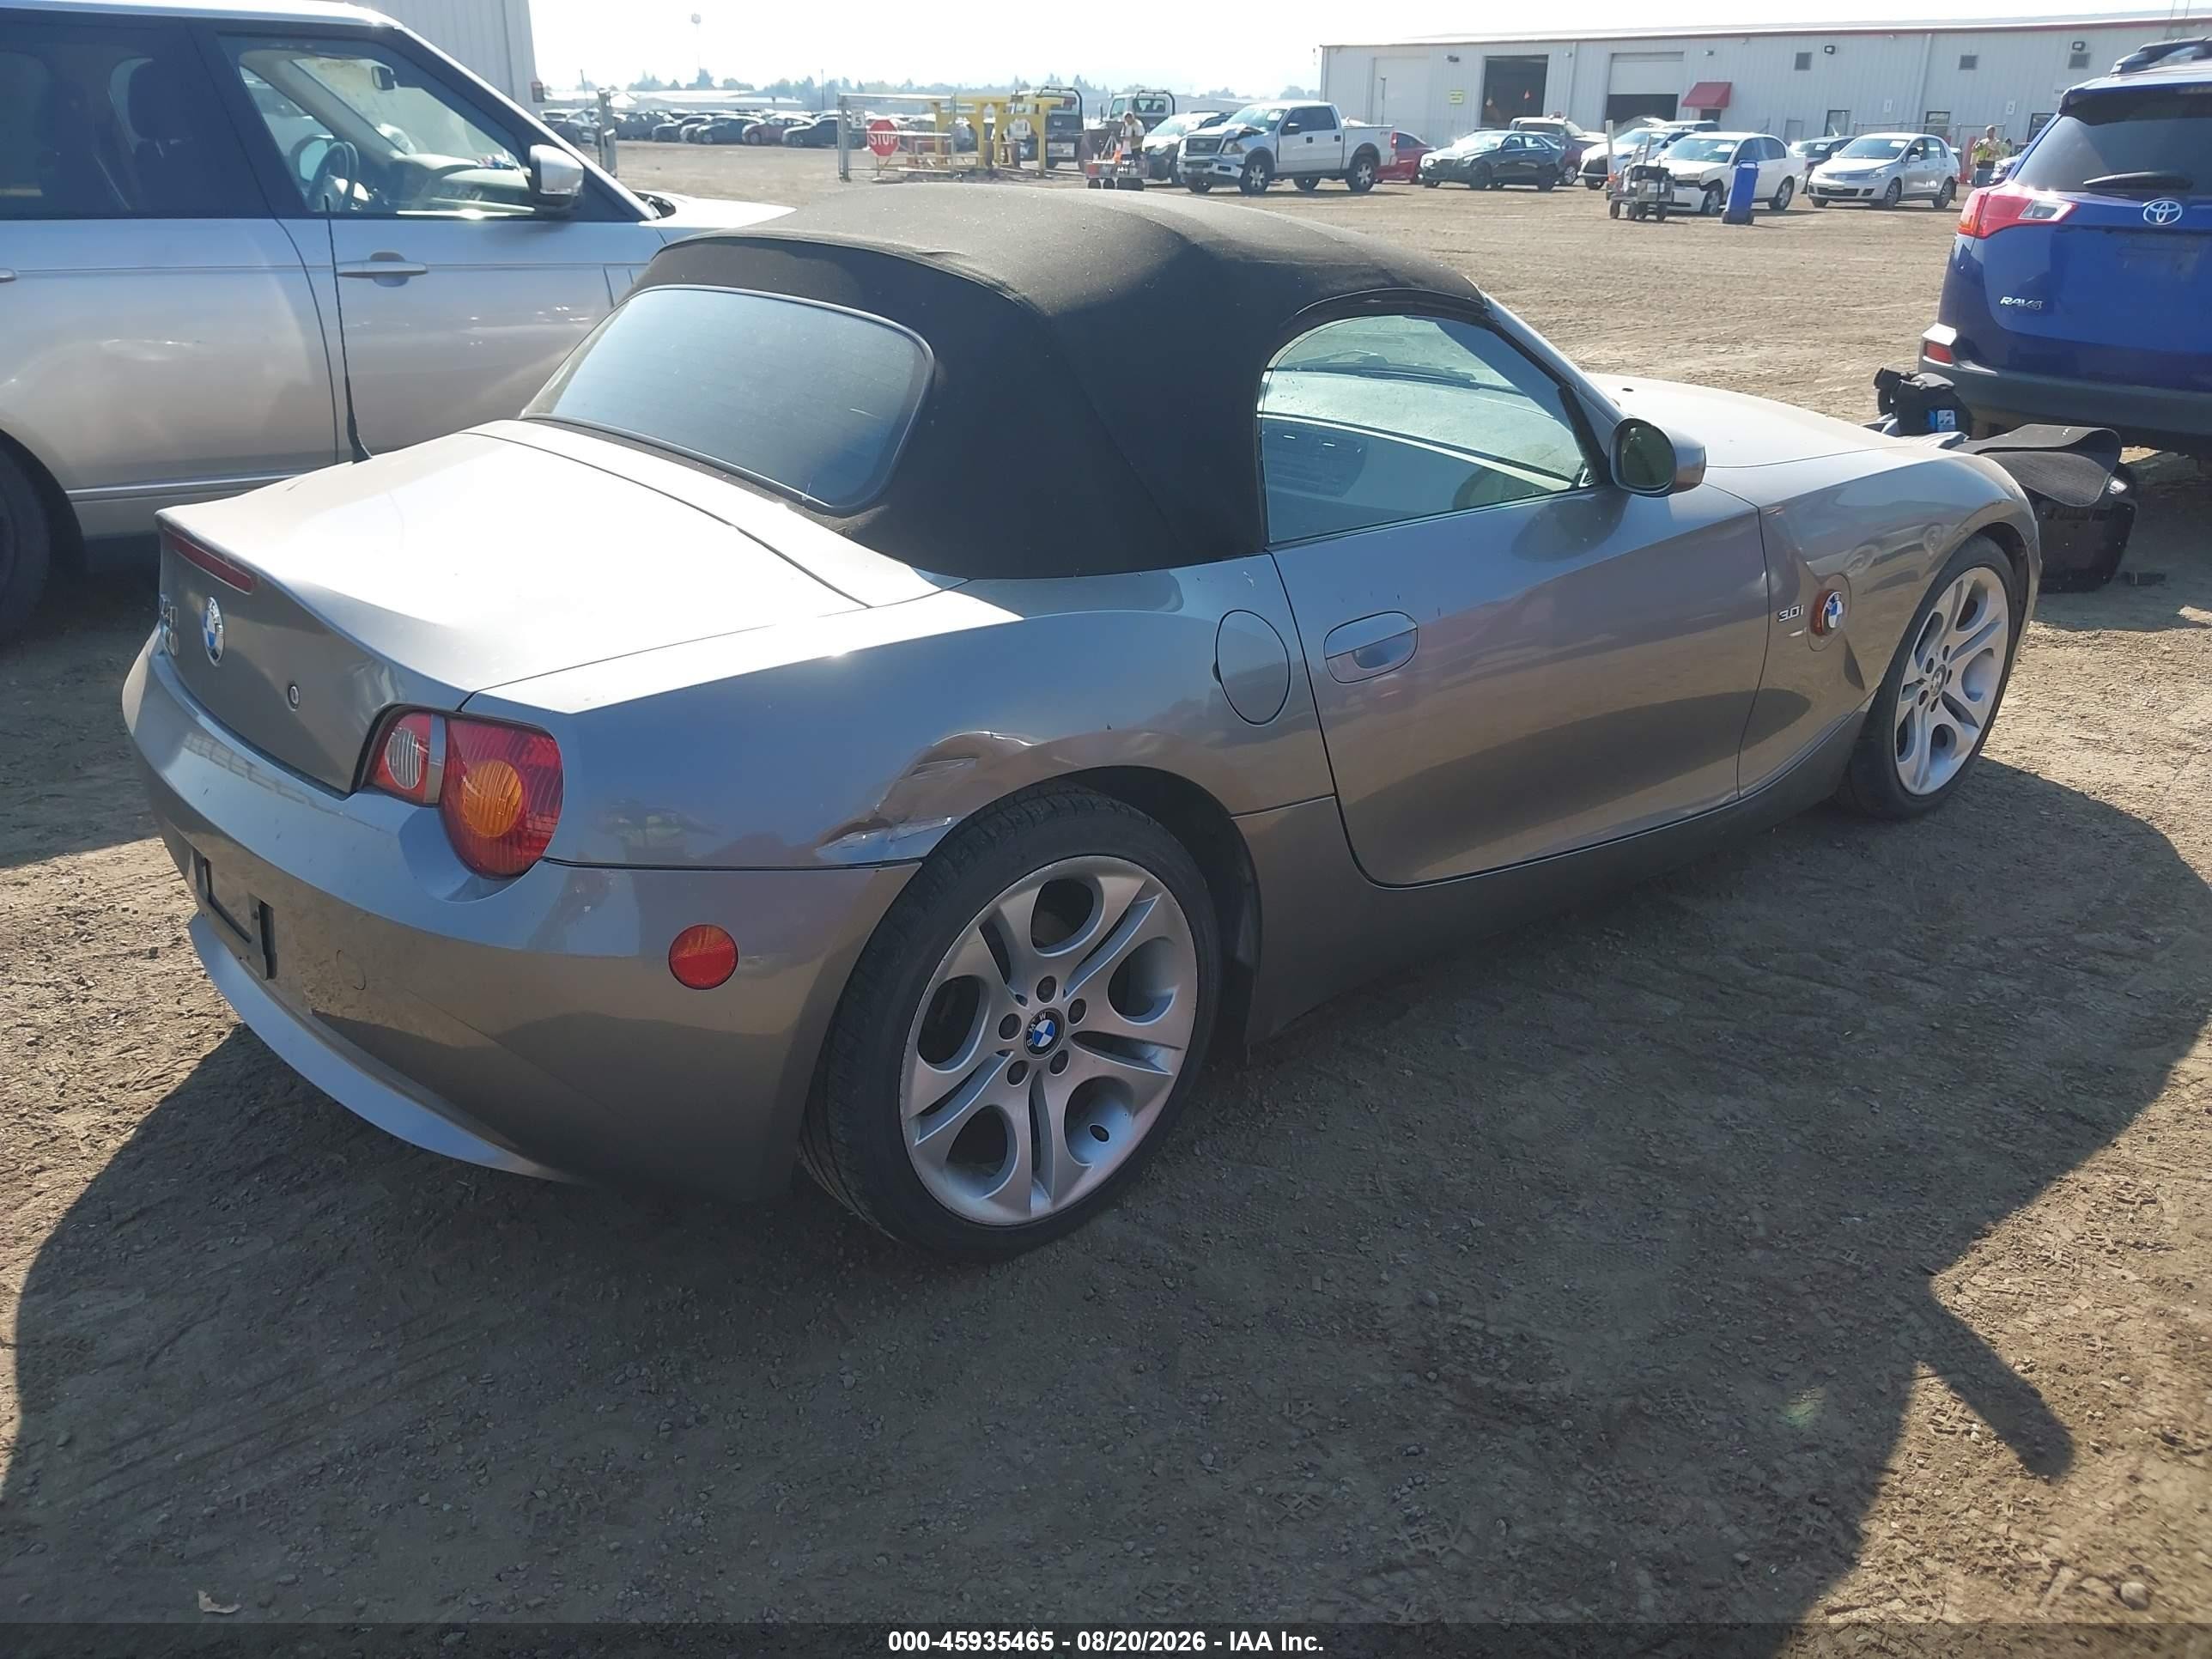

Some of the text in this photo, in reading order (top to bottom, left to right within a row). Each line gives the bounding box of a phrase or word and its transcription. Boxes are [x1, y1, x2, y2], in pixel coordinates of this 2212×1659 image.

[854, 116, 862, 127] 5
[869, 132, 897, 145] STOP
[1999, 295, 2044, 310] RAV4
